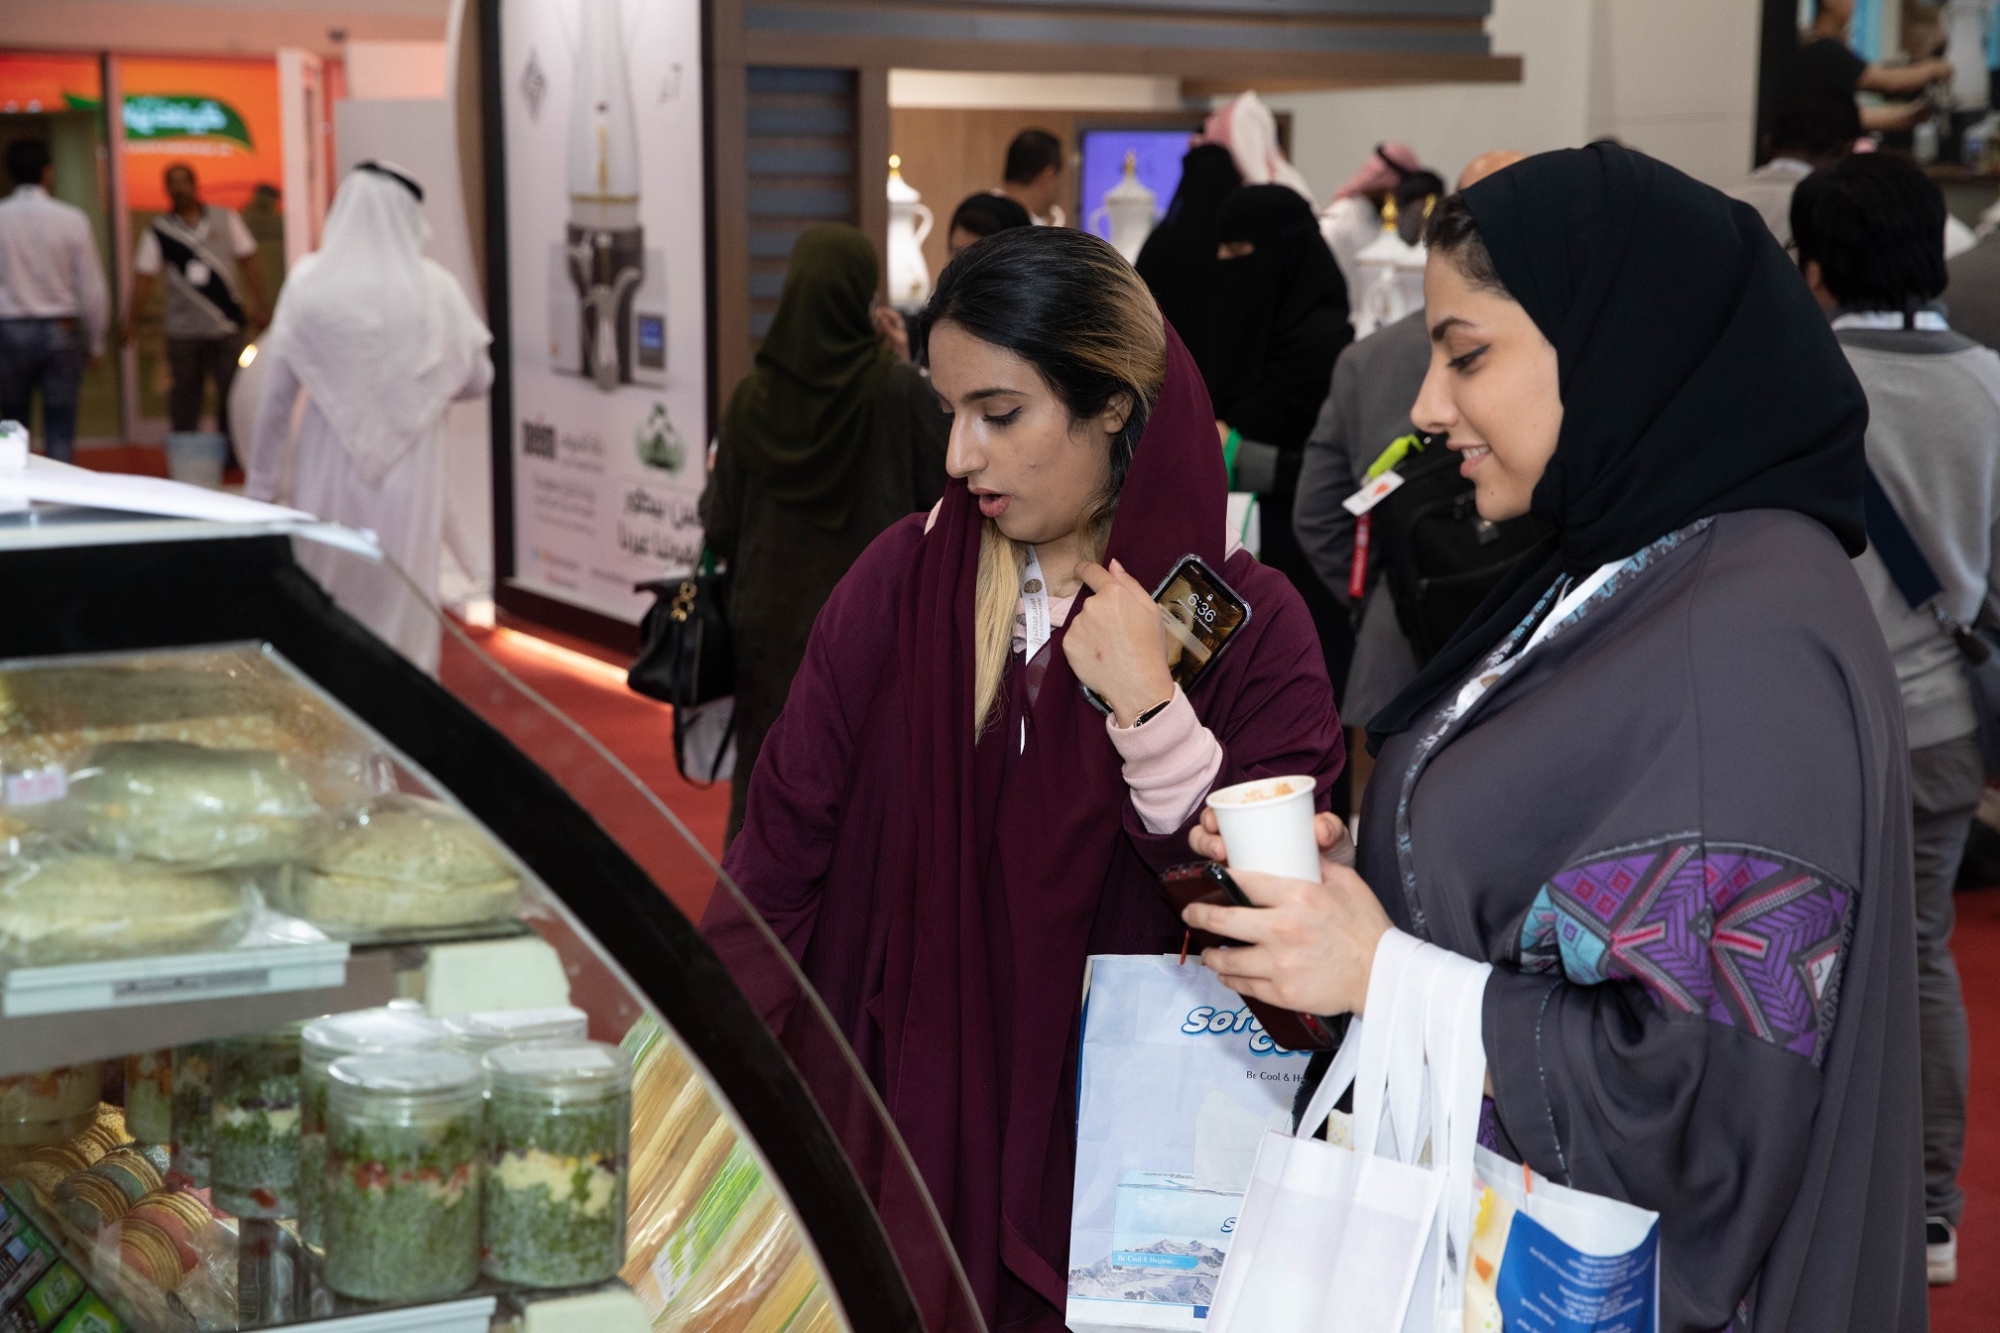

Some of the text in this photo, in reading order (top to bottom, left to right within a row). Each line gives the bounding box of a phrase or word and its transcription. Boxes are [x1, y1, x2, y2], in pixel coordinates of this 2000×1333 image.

[1188, 593, 1217, 622] 6:36
[1260, 1071, 1281, 1081] Cool
[1283, 1072, 1290, 1082] &
[1127, 1255, 1142, 1263] Cool
